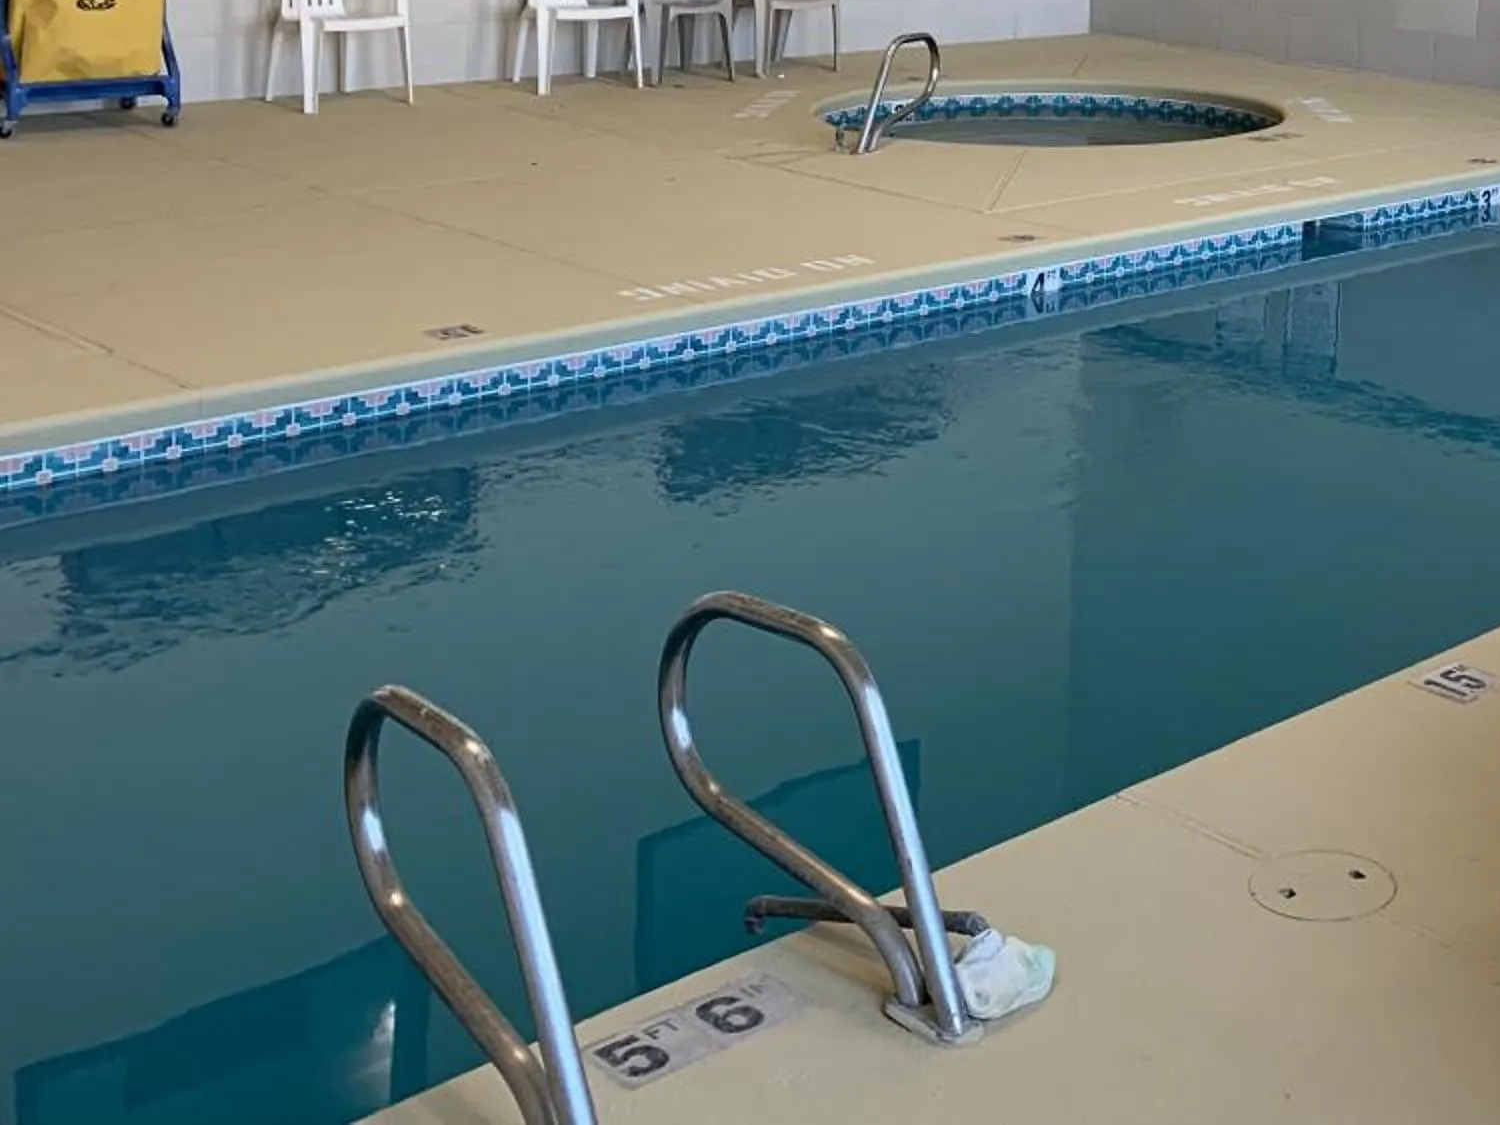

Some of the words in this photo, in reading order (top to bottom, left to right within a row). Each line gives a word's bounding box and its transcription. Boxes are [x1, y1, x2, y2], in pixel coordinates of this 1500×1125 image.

[800, 254, 876, 271] NO
[616, 267, 798, 300] DIVING
[592, 1034, 671, 1078] 5
[695, 995, 766, 1034] 6
